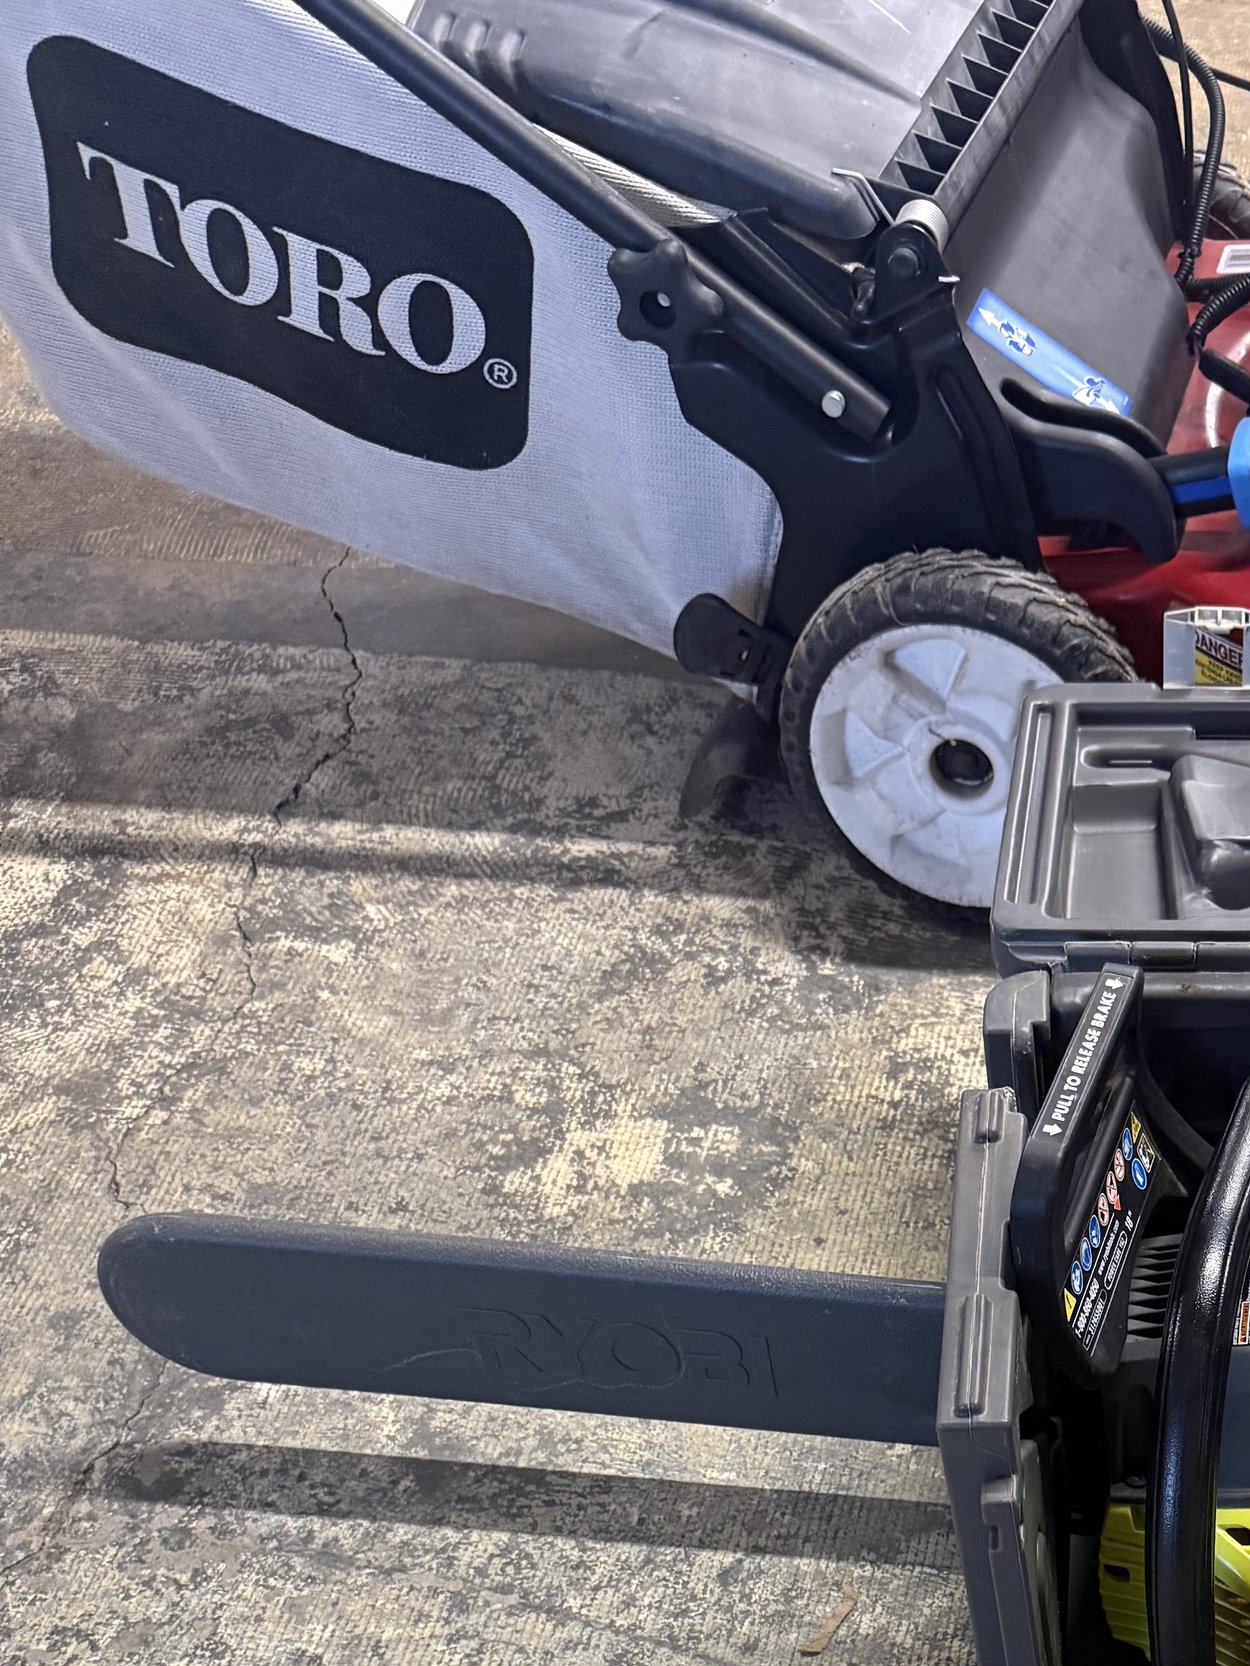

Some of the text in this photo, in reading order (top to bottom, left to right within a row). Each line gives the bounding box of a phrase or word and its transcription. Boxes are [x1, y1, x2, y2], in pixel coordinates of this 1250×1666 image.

[1051, 990, 1117, 1122] PULL TO RELEASE BRAKE
[458, 1305, 781, 1398] RYOBI
